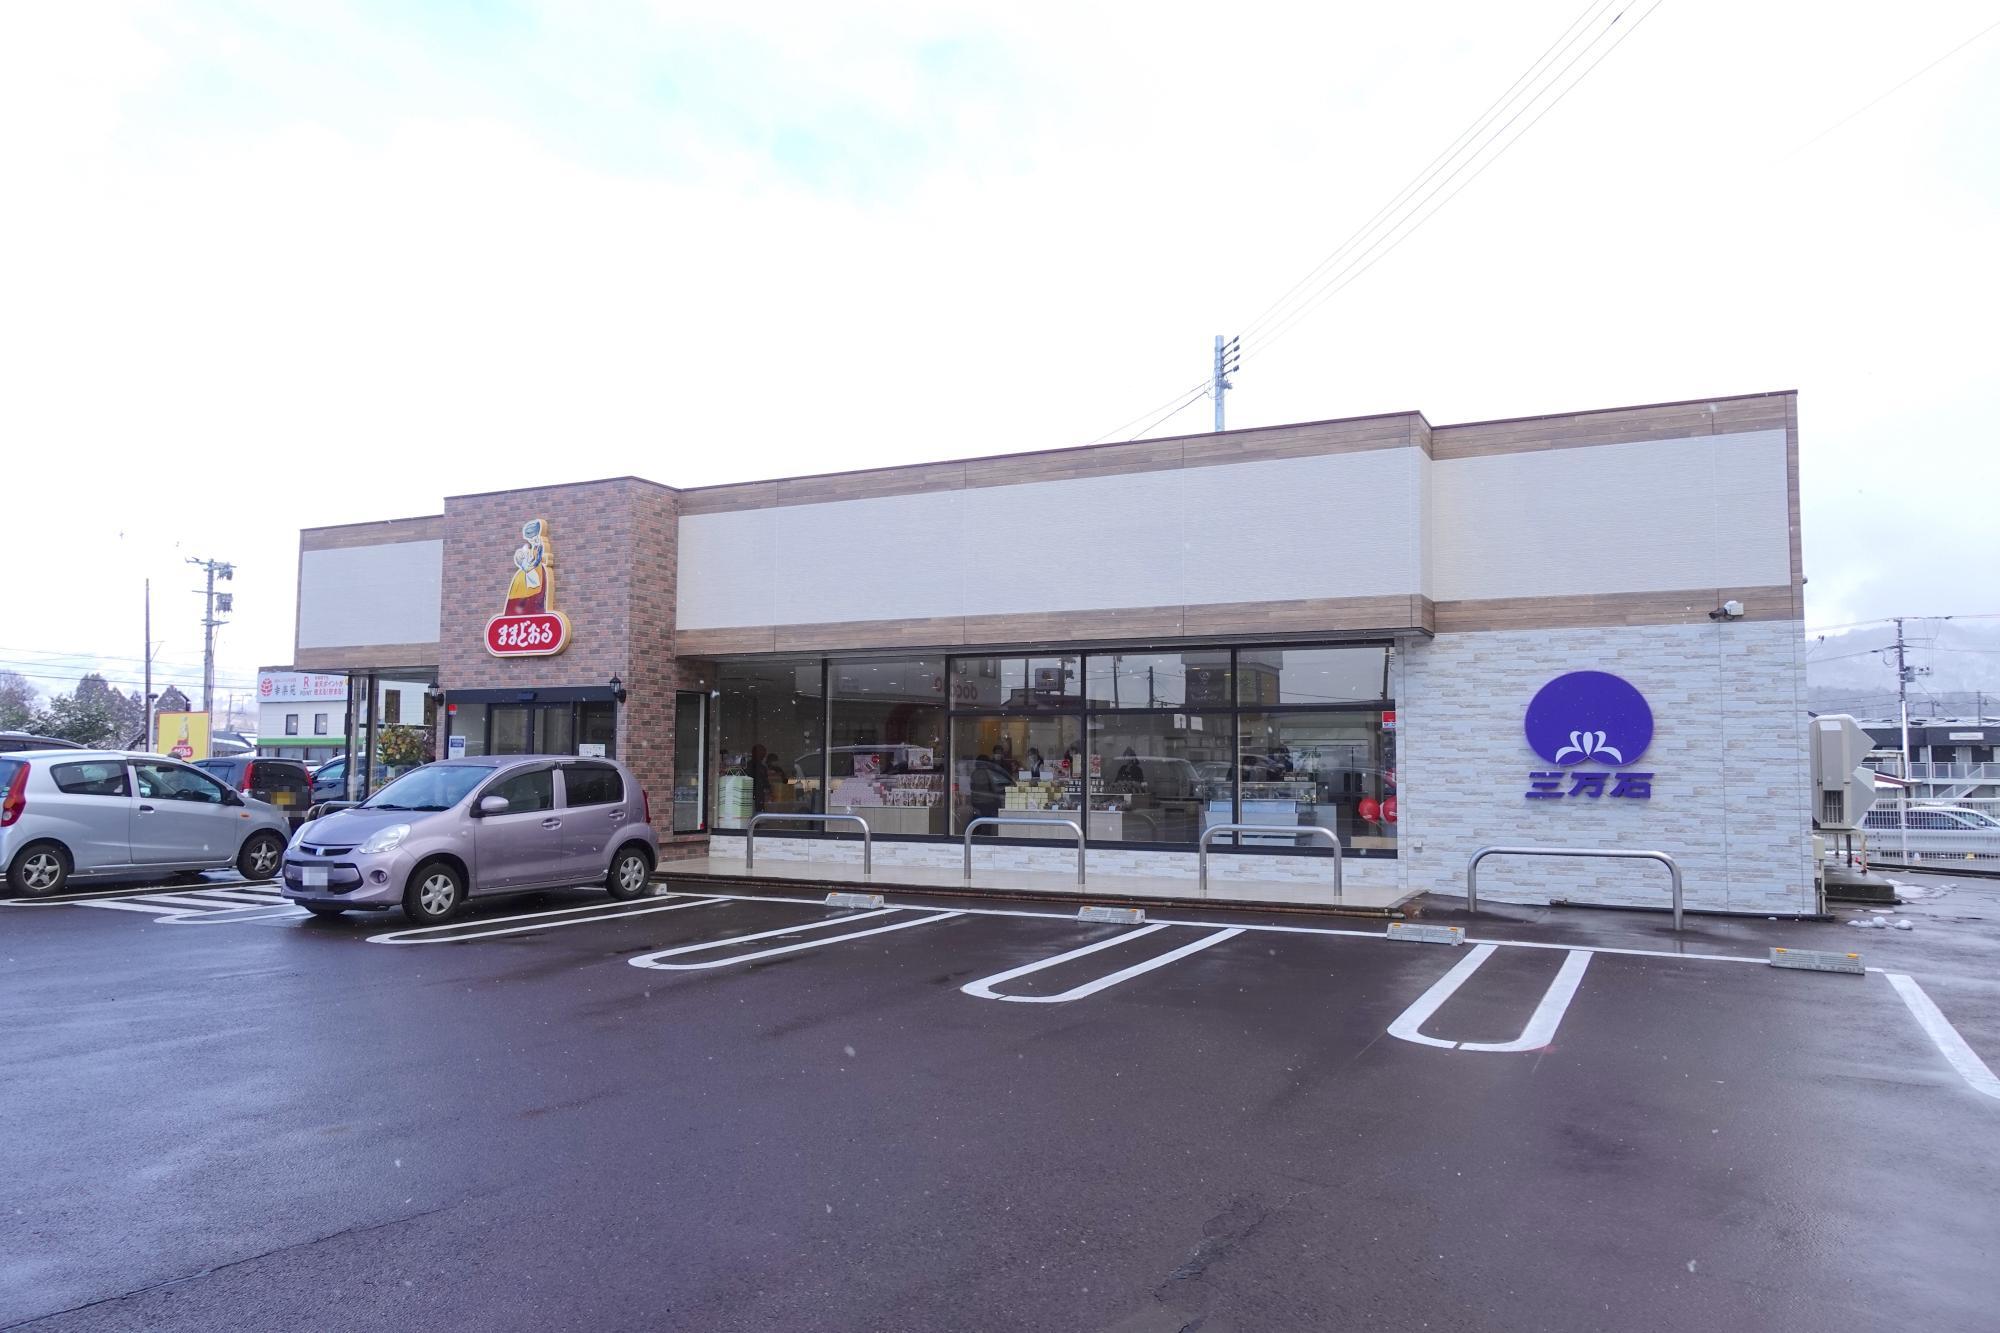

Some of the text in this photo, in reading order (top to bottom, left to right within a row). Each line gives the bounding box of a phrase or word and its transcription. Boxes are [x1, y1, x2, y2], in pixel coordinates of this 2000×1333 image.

[498, 620, 553, 647] ままどおる
[1525, 771, 1656, 799] 三万石
